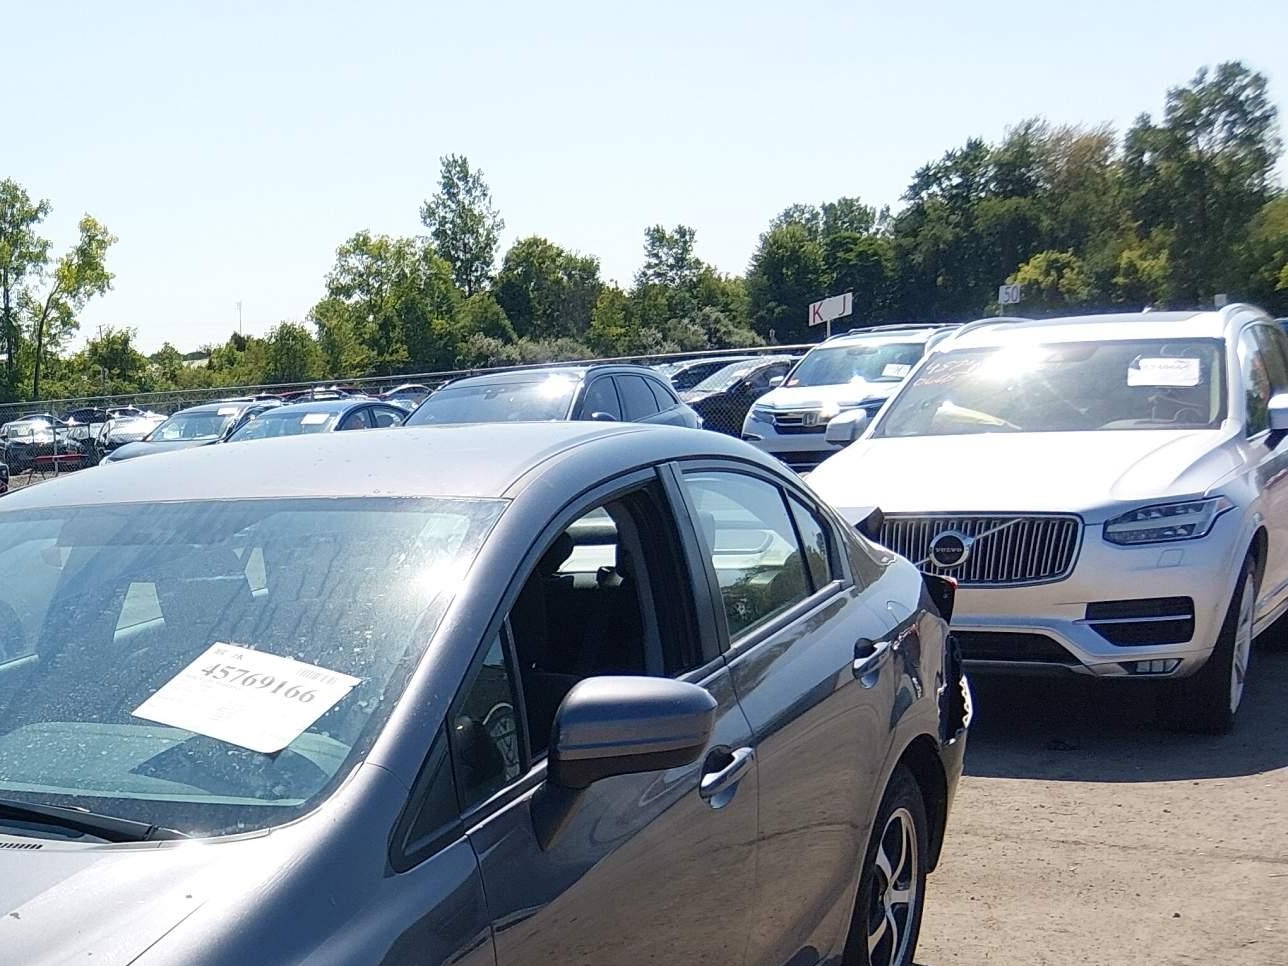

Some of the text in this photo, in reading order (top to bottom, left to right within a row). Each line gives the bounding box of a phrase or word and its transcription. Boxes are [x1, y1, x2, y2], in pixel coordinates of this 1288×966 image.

[812, 295, 847, 324] K J
[200, 663, 319, 704] 45769166
